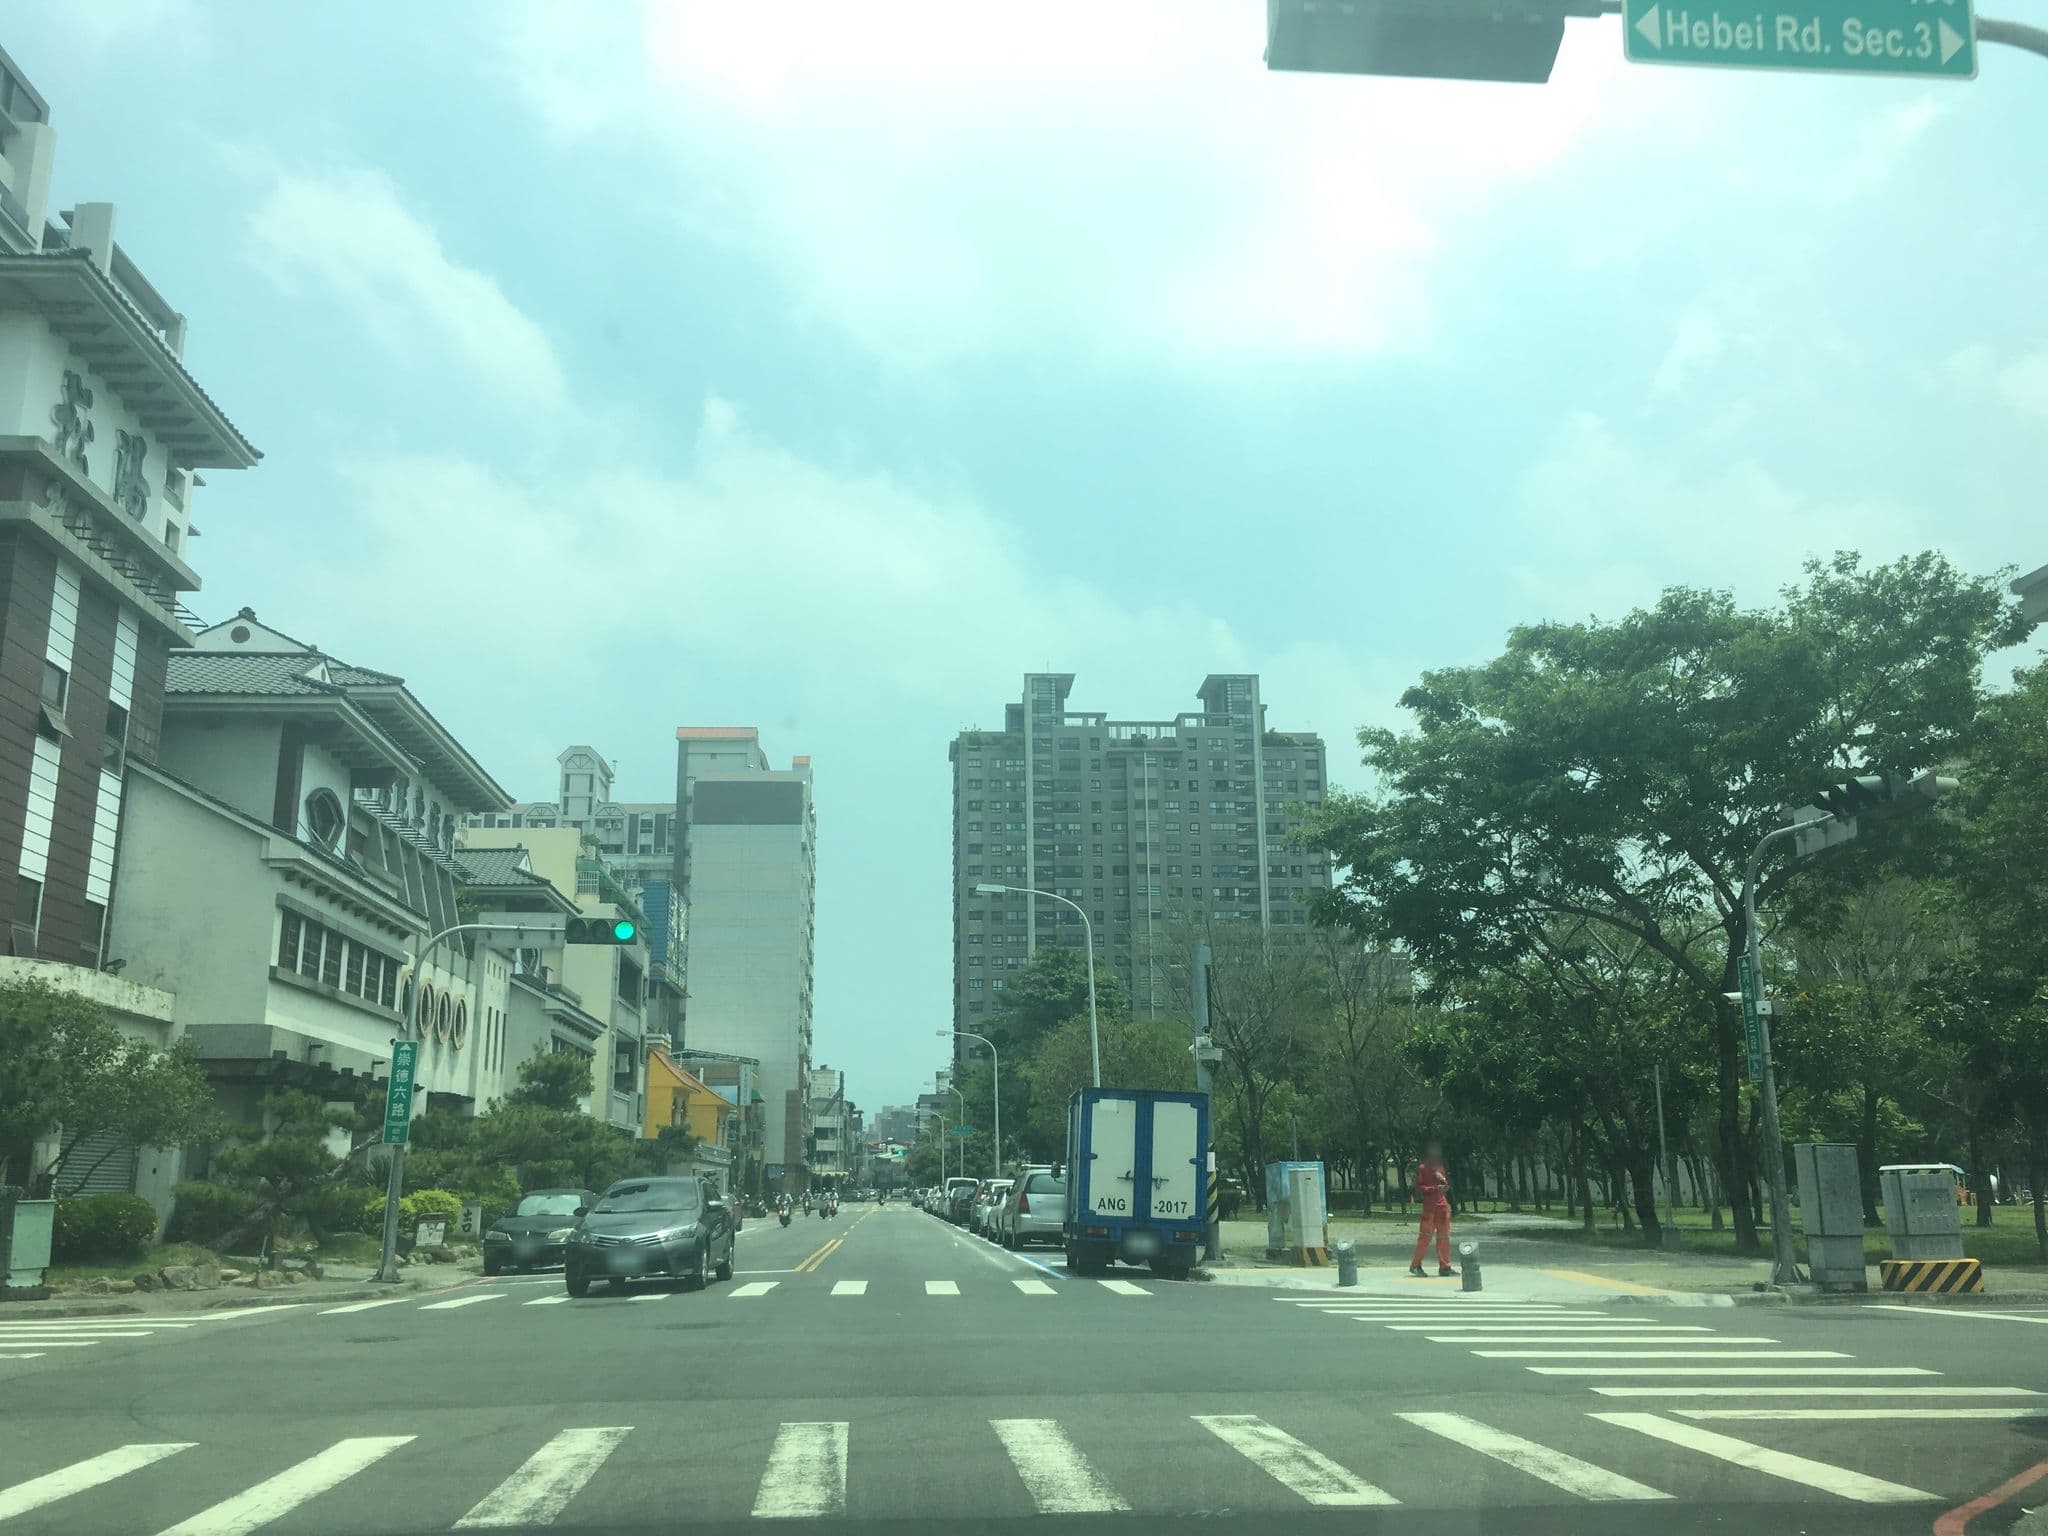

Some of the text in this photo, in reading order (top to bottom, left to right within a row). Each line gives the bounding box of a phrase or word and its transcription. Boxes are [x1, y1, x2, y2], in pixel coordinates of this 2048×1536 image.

[1665, 9, 1933, 58] Hebei Rd. Sec.3
[391, 1052, 411, 1117] 崇德六路
[1097, 1198, 1126, 1211] ANG
